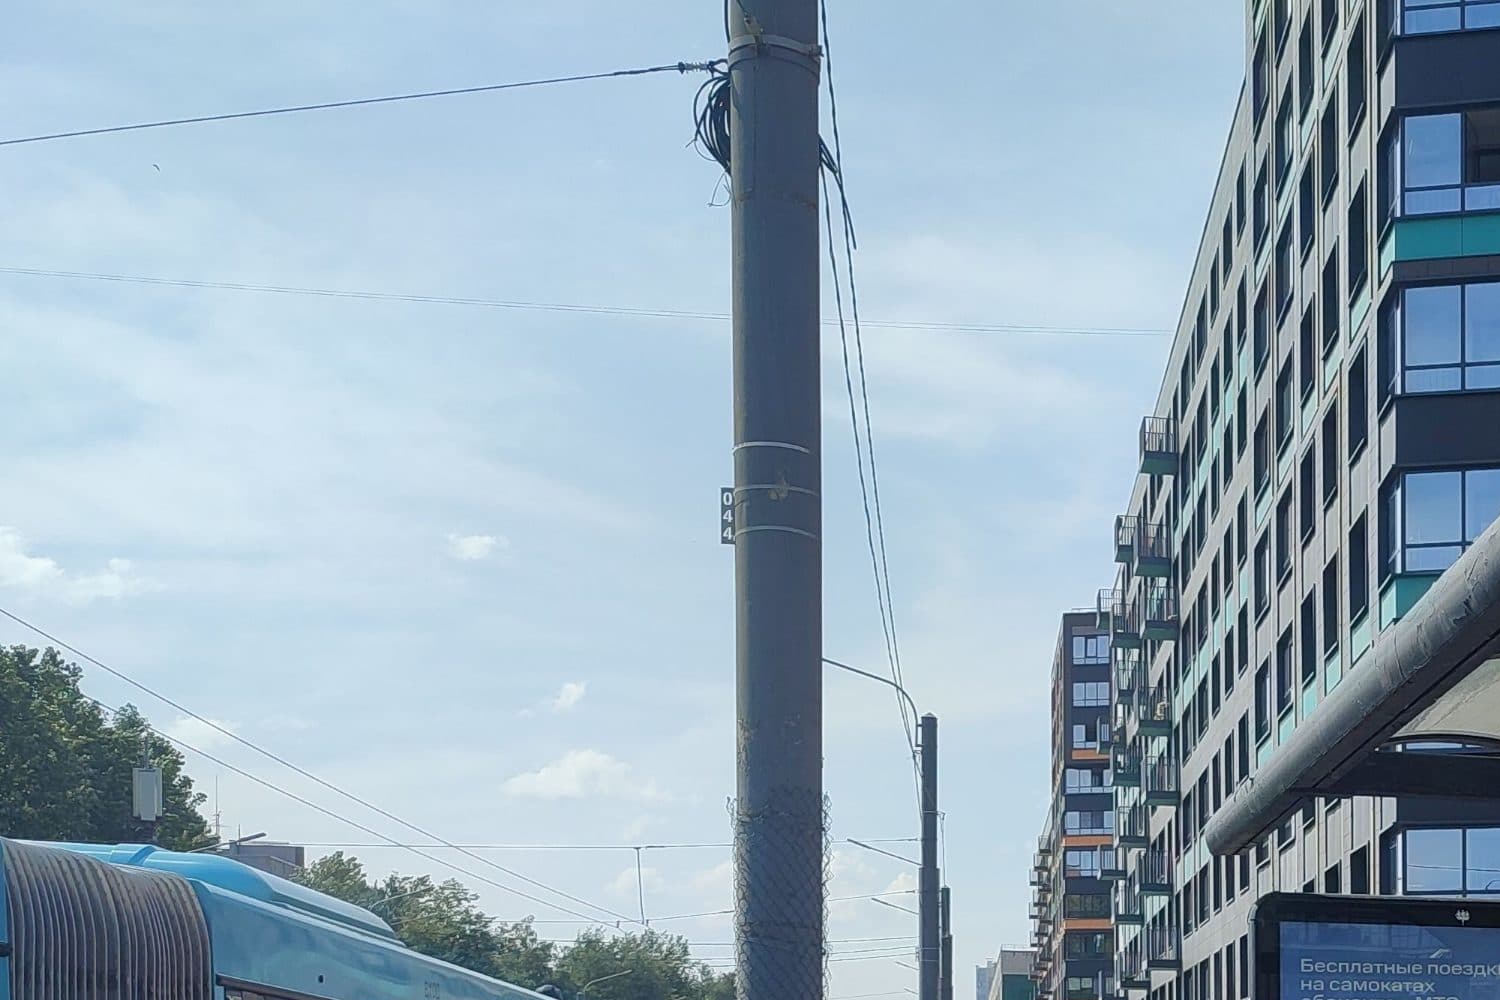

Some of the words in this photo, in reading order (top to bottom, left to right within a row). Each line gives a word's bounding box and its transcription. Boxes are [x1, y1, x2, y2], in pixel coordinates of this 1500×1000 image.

[1300, 958, 1423, 975] Бесплатные
[1300, 979, 1324, 991] на
[1329, 980, 1436, 993] самокатах
